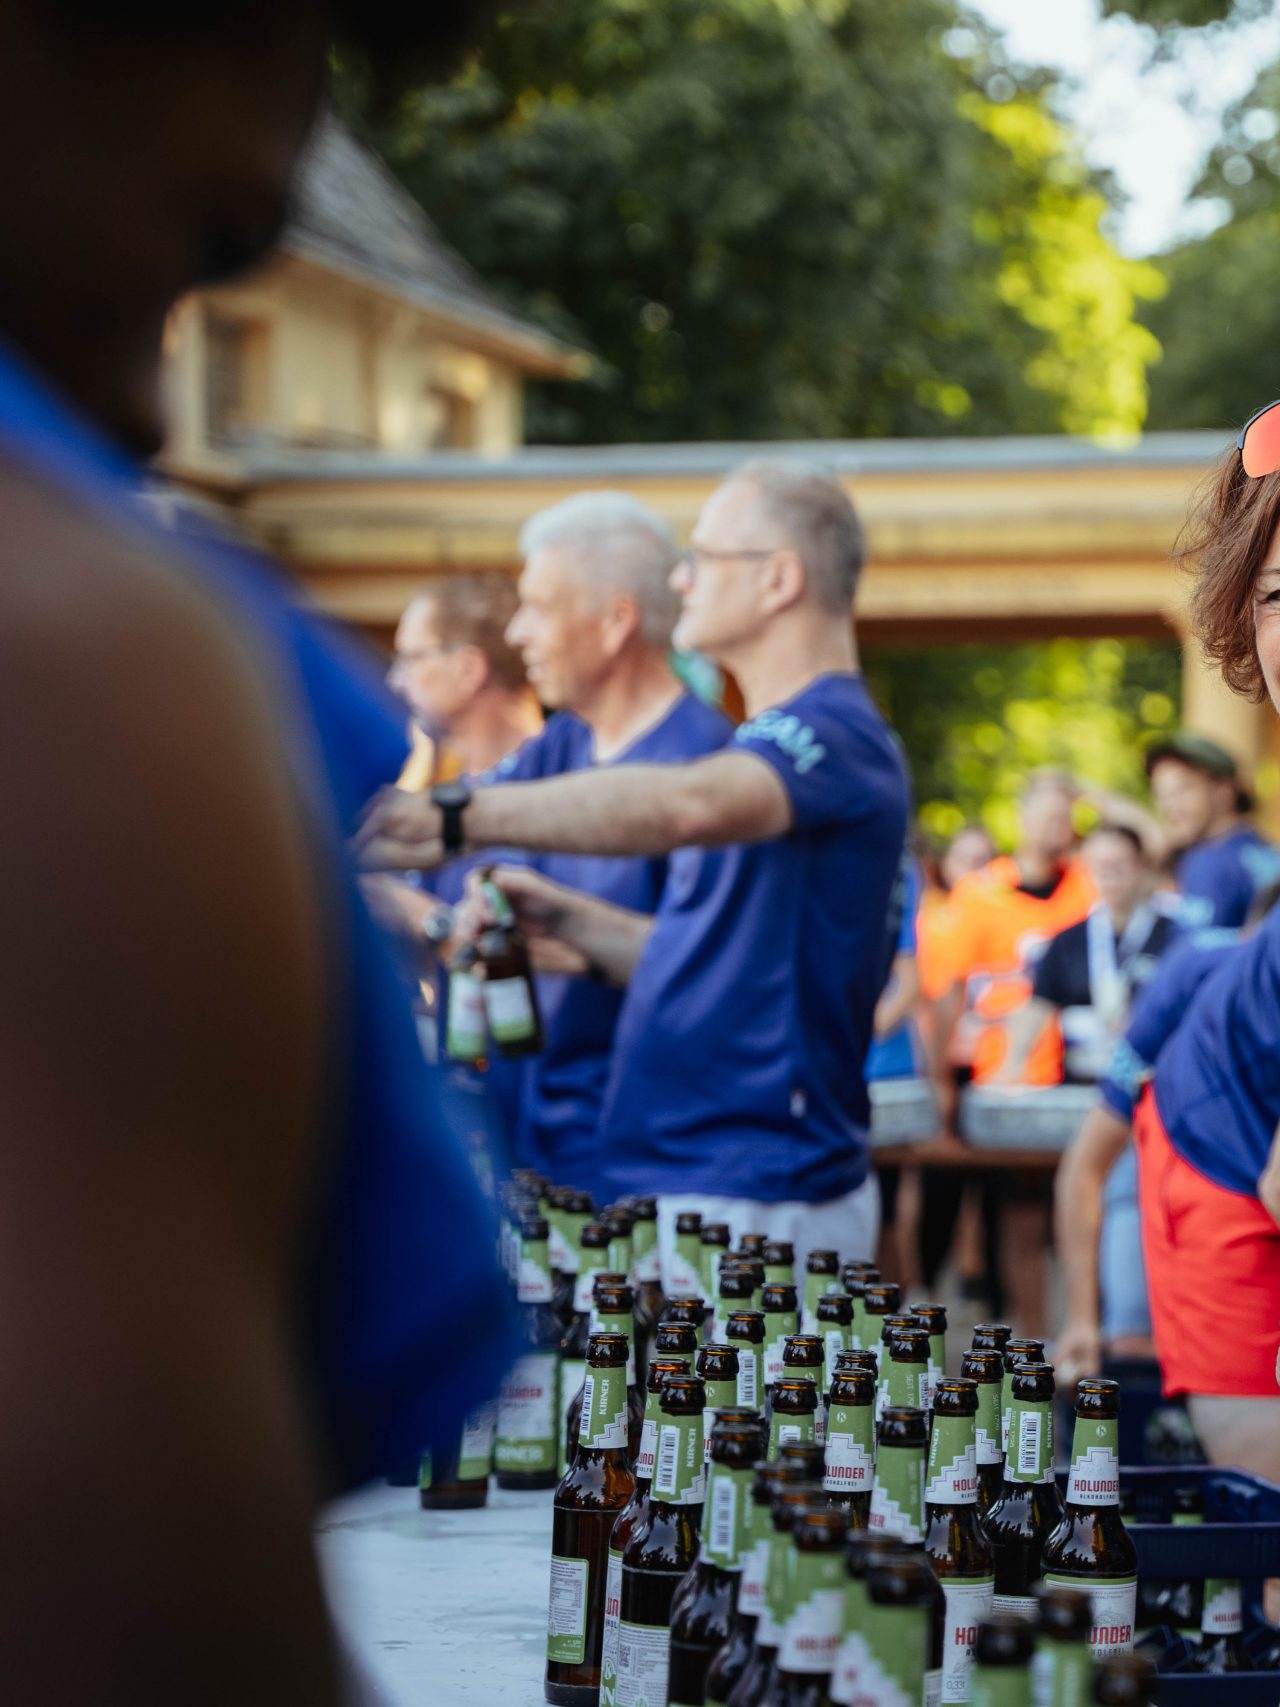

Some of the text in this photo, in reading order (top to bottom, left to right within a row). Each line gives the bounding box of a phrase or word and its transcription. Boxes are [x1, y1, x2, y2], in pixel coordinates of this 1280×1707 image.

[599, 1379, 610, 1415] KIRNER
[824, 1466, 865, 1479] LUNDER
[1074, 1479, 1119, 1492] HOLUNDE
[1088, 1624, 1132, 1645] UNDER
